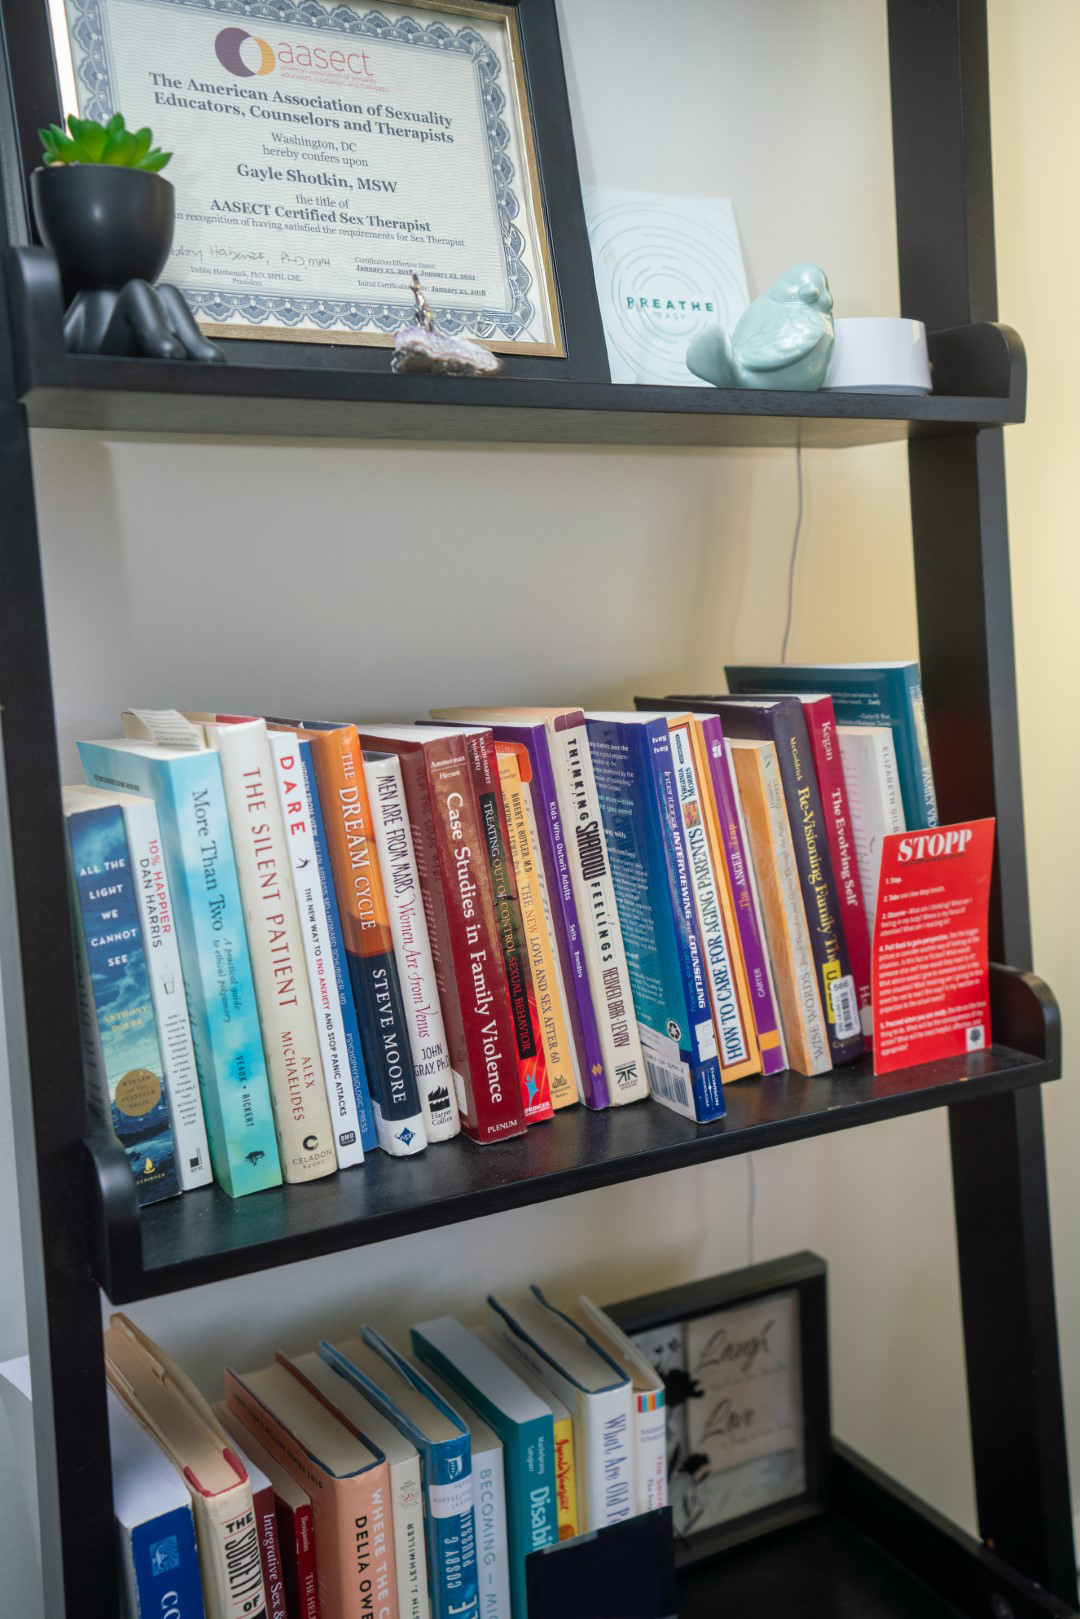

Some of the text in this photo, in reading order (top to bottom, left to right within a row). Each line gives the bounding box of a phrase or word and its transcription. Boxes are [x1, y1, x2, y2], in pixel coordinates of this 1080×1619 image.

[277, 42, 374, 76] aasect
[149, 72, 182, 89] The
[187, 78, 267, 101] American
[273, 91, 363, 115] Association
[367, 104, 382, 116] of
[385, 106, 453, 129] Sexuality
[153, 91, 454, 144] Educators, Counselors and Therapists
[263, 145, 369, 168] hereby confers upon
[271, 132, 357, 152] Washington, DC
[236, 164, 398, 194] Gayle Shotkin, MSW
[295, 194, 349, 209] the title of
[186, 213, 465, 248] recognition of having satisfied the requirements for Sex Therapist
[210, 199, 432, 233] AASECT Certified Sex Therapist
[627, 296, 714, 312] BREATHE
[430, 755, 465, 769] Ammerman
[822, 722, 833, 760] Kegan
[280, 755, 306, 836] DARE
[439, 769, 461, 780] Hersen
[567, 738, 589, 821] THINKING
[676, 767, 688, 800] VIRGINIA
[683, 766, 695, 796] MORRIS
[883, 746, 896, 808] ELIZABETH
[922, 766, 932, 808] FAMILY
[510, 792, 523, 820] ROBERT
[191, 789, 226, 931] More Than Two
[338, 752, 376, 931] THE DREAM CYCLE
[376, 775, 415, 899] MEN ARE FROM MARS,
[549, 801, 571, 901] Kids Who Outwit Adults
[576, 820, 606, 881] SHADOW
[797, 785, 823, 885] Re-Visioning
[814, 883, 835, 934] Family
[831, 787, 858, 906] The Evolving Self
[897, 829, 973, 862] STOPP
[79, 858, 126, 877] ALL THE
[89, 884, 123, 900] LIGHT
[148, 839, 172, 934] 10% HAPPIER
[243, 767, 298, 1006] THE SILENT PATIENT
[728, 824, 750, 910] The ANGER Trap
[101, 909, 119, 920] WE
[140, 858, 163, 948] DAN HARRIS
[398, 894, 417, 947] Women
[483, 800, 531, 1051] TREATING OUT CONTROL SEXUAL BEHAVIOR
[591, 881, 613, 962] FEELINGS
[674, 832, 706, 1008] INTERVIEWING COUNSELING
[90, 928, 138, 947] CANNOT
[107, 954, 128, 967] SEE
[446, 792, 503, 1103] Case Studies in Family Violence
[689, 828, 743, 1060] HOW TO CARE FOR AGING PARENTS
[224, 948, 242, 1010] practical guide
[408, 972, 425, 1004] from
[521, 883, 561, 1063] THE NEW LOVE AND SEX AFTER 60
[754, 968, 765, 998] CARTER
[304, 888, 347, 1117] THE NEW WAY TO END ANXIETY AND STOP PANIC ATTACKS
[416, 1003, 438, 1038] Venus
[802, 972, 823, 1059] WISE WORDS
[372, 968, 406, 1104] STEVE MOORE
[421, 1043, 443, 1061] JOHN
[236, 1055, 254, 1127] VEAUX RICKERT
[280, 1031, 305, 1121] MICHAELIDES
[302, 1056, 316, 1089] ALEX
[359, 1110, 368, 1133] PRESS
[431, 1110, 452, 1120] Harper
[431, 1116, 453, 1126] Collins
[487, 1119, 518, 1134] PLENUM
[292, 1149, 332, 1166] CELADON
[307, 1472, 323, 1489] SOLD
[603, 1413, 630, 1508] What Are Old
[226, 1511, 253, 1533] THE
[480, 1468, 496, 1566] BECOMING
[224, 1528, 263, 1599] SOCIETY
[263, 1513, 283, 1608] Integrative Sex
[355, 1515, 370, 1574] DELIA
[371, 1487, 389, 1601] WHERE THE
[407, 1523, 417, 1584] LEHMILLER
[243, 1595, 260, 1612] OF
[305, 1572, 314, 1596] THE
